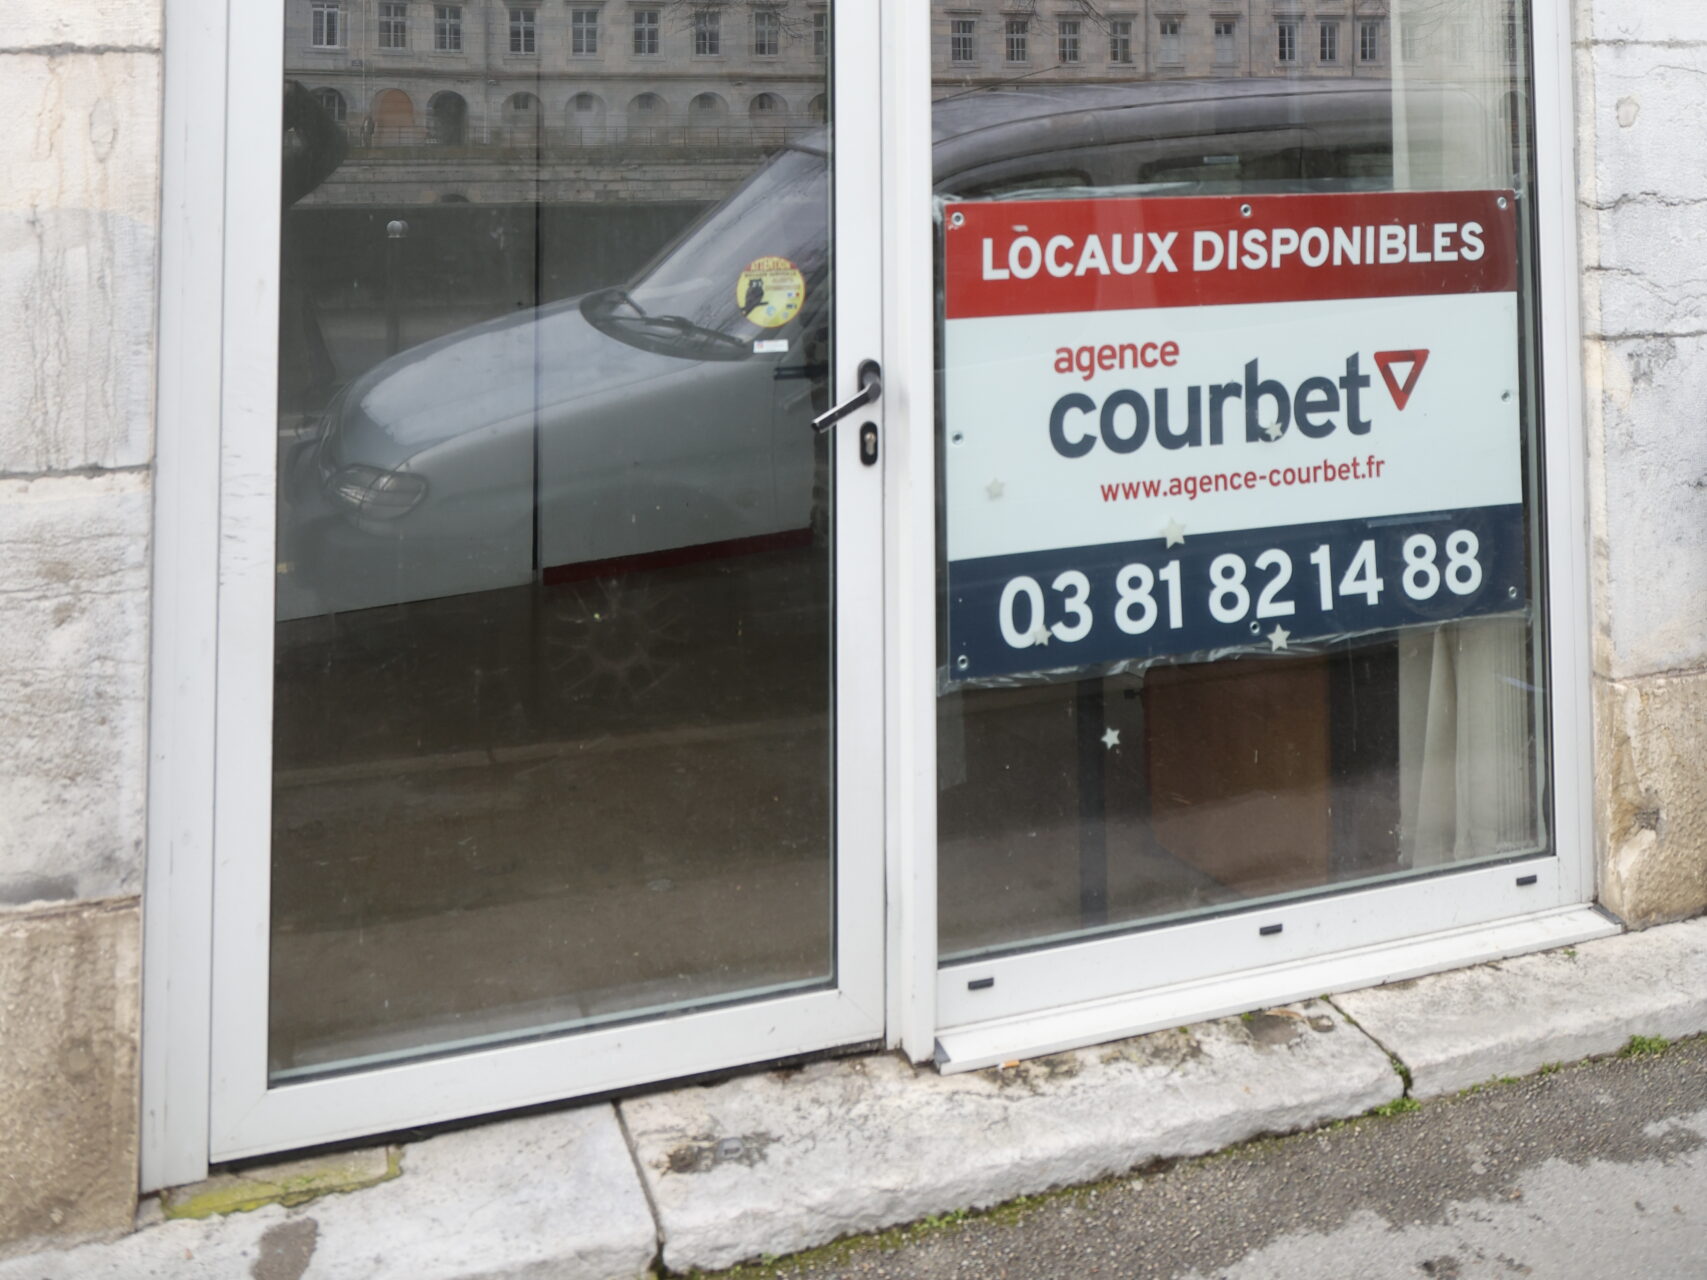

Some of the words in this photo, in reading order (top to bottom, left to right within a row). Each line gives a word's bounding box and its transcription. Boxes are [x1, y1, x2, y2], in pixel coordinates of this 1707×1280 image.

[982, 230, 1179, 281] LOCAUX
[1193, 222, 1486, 272] DISPONIBLES
[1054, 339, 1181, 381] agence
[1048, 351, 1372, 458] courbet
[1100, 454, 1386, 503] www.agence-courbet.fr
[999, 570, 1094, 649] 03
[1114, 559, 1184, 636] 81
[1208, 548, 1297, 625] 82
[1310, 538, 1384, 612] 14
[1402, 528, 1484, 602] 88
